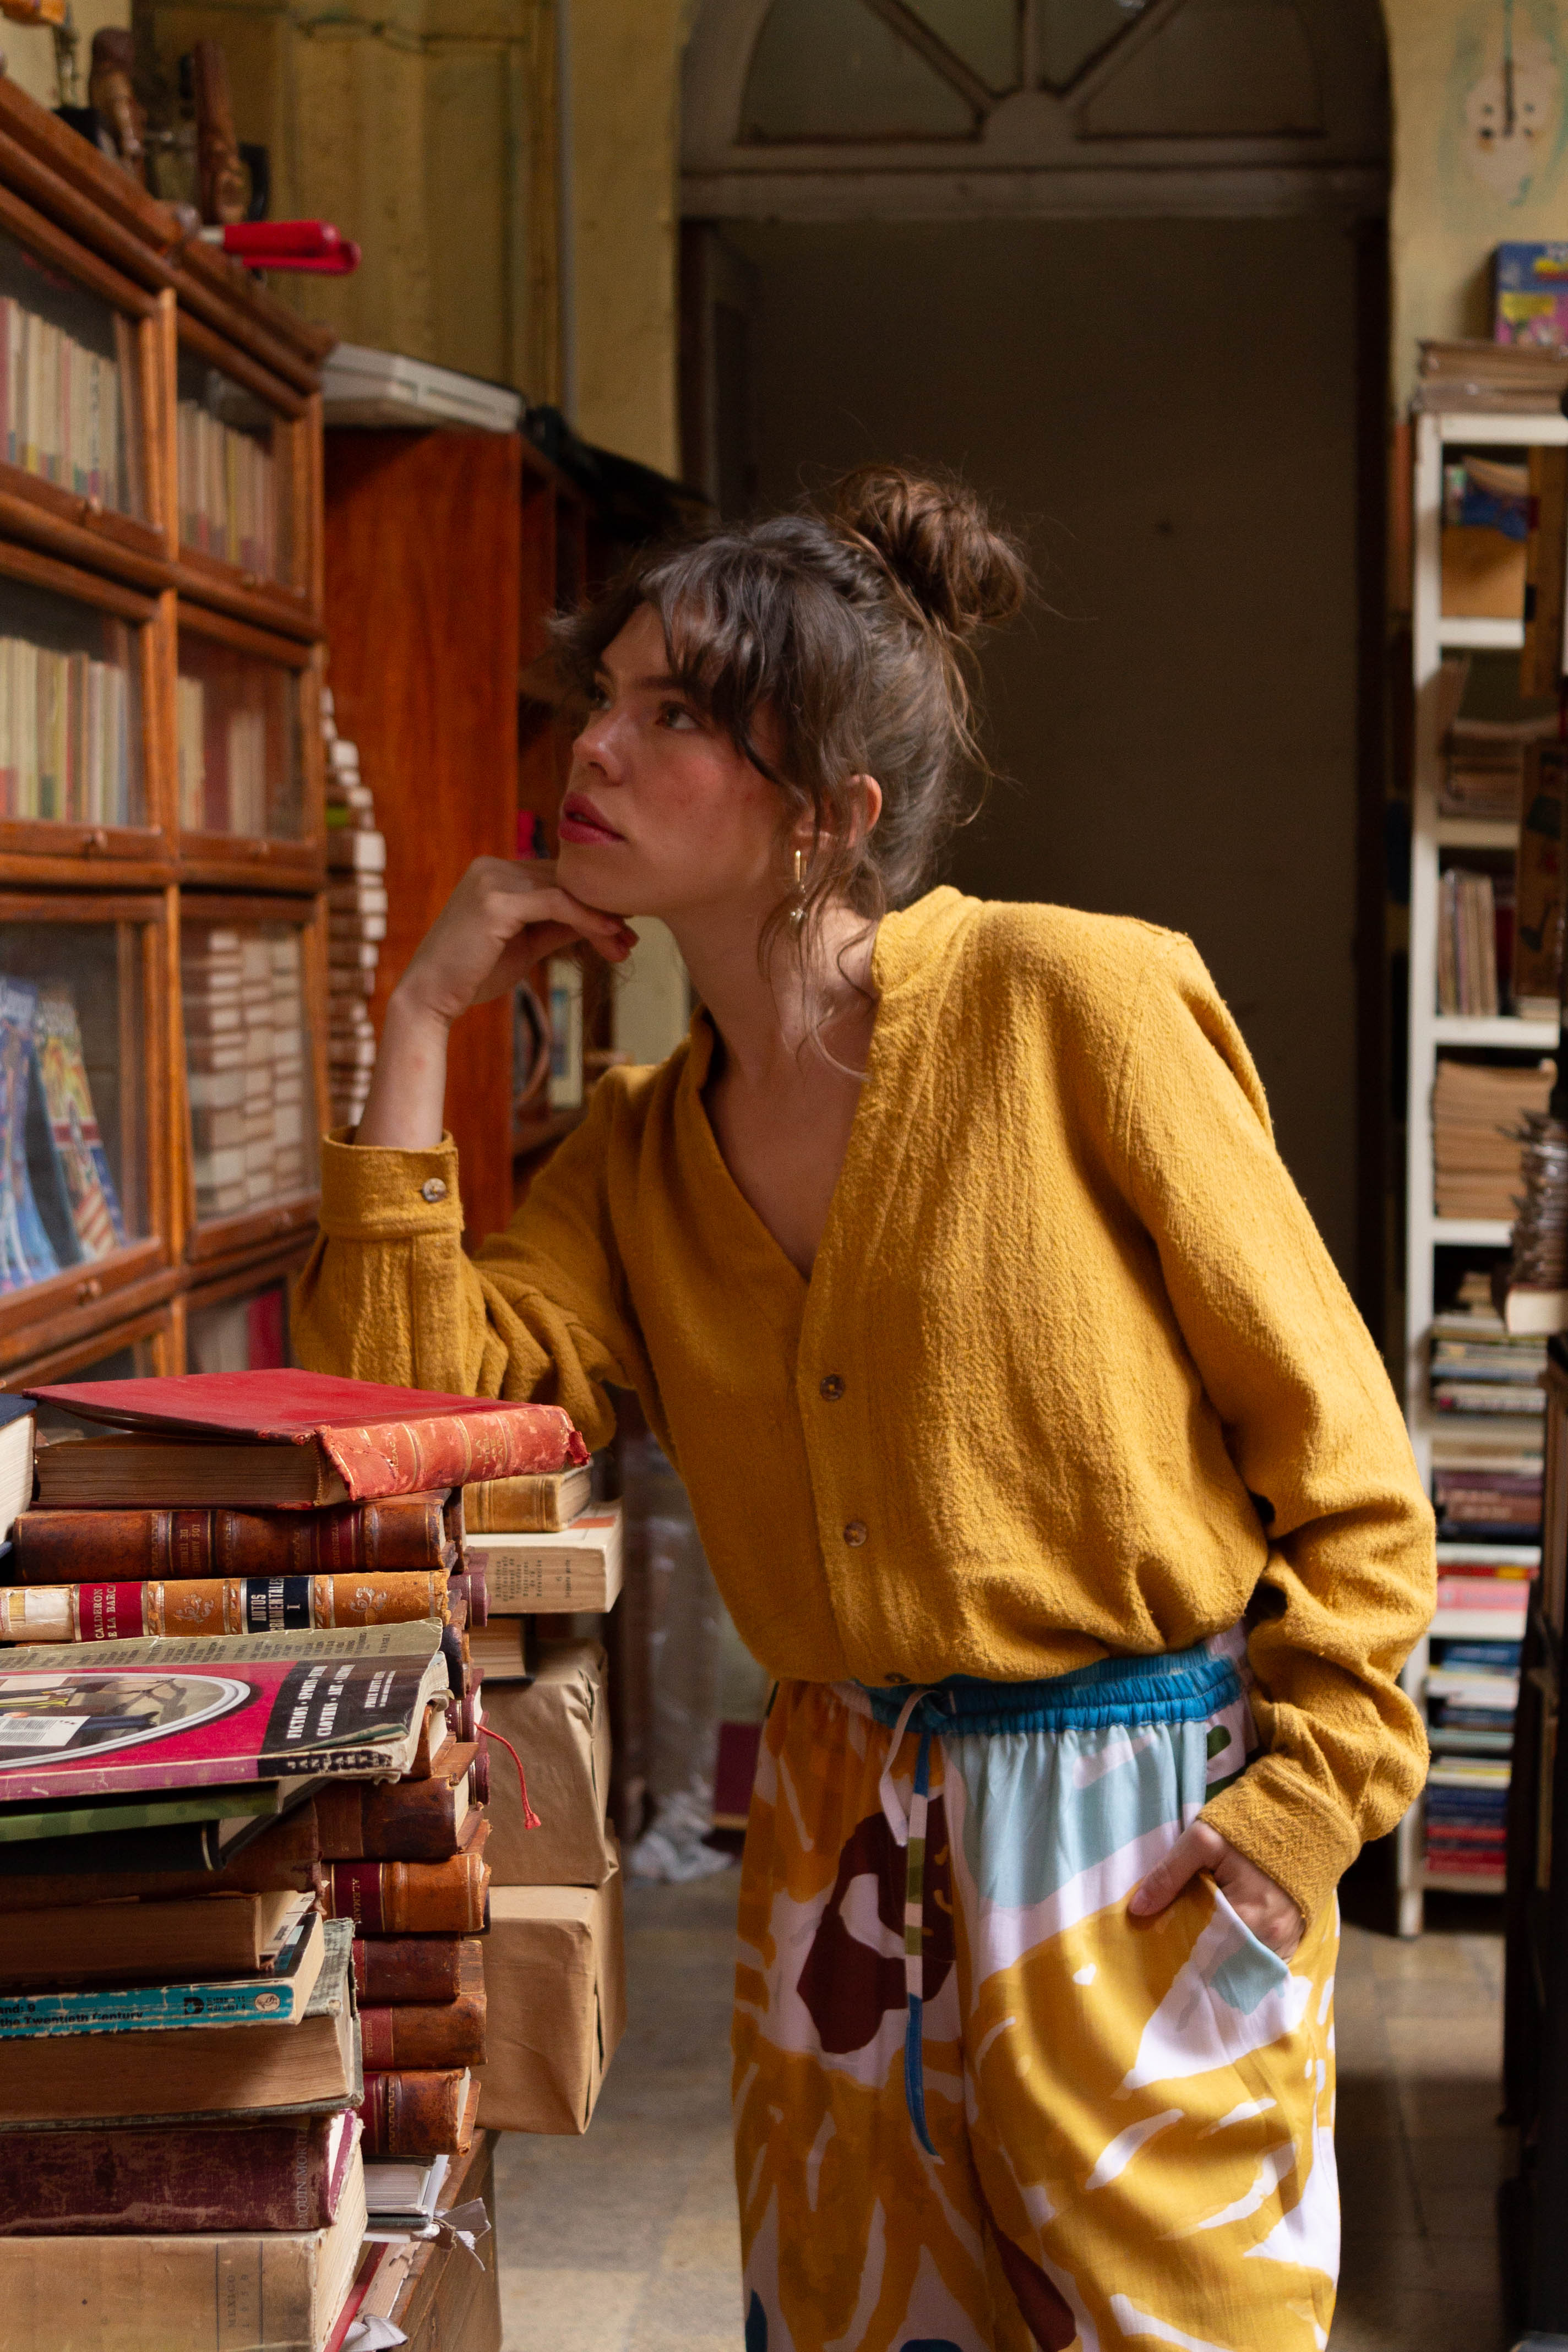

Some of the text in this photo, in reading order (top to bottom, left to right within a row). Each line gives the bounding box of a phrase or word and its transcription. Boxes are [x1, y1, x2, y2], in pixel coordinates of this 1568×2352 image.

[192, 1524, 201, 1538] LOS
[92, 1588, 105, 1638] CALDERON
[107, 1616, 116, 1630] LA
[251, 1594, 267, 1621] AUTOS
[286, 1706, 309, 1739] FICTION
[298, 1679, 318, 1700] SPORTS
[317, 1702, 339, 1736] CLOTHES
[328, 1685, 344, 1695] ART
[0, 2011, 144, 2027] the Twentieth Century
[227, 2274, 236, 2328] MEXICO
